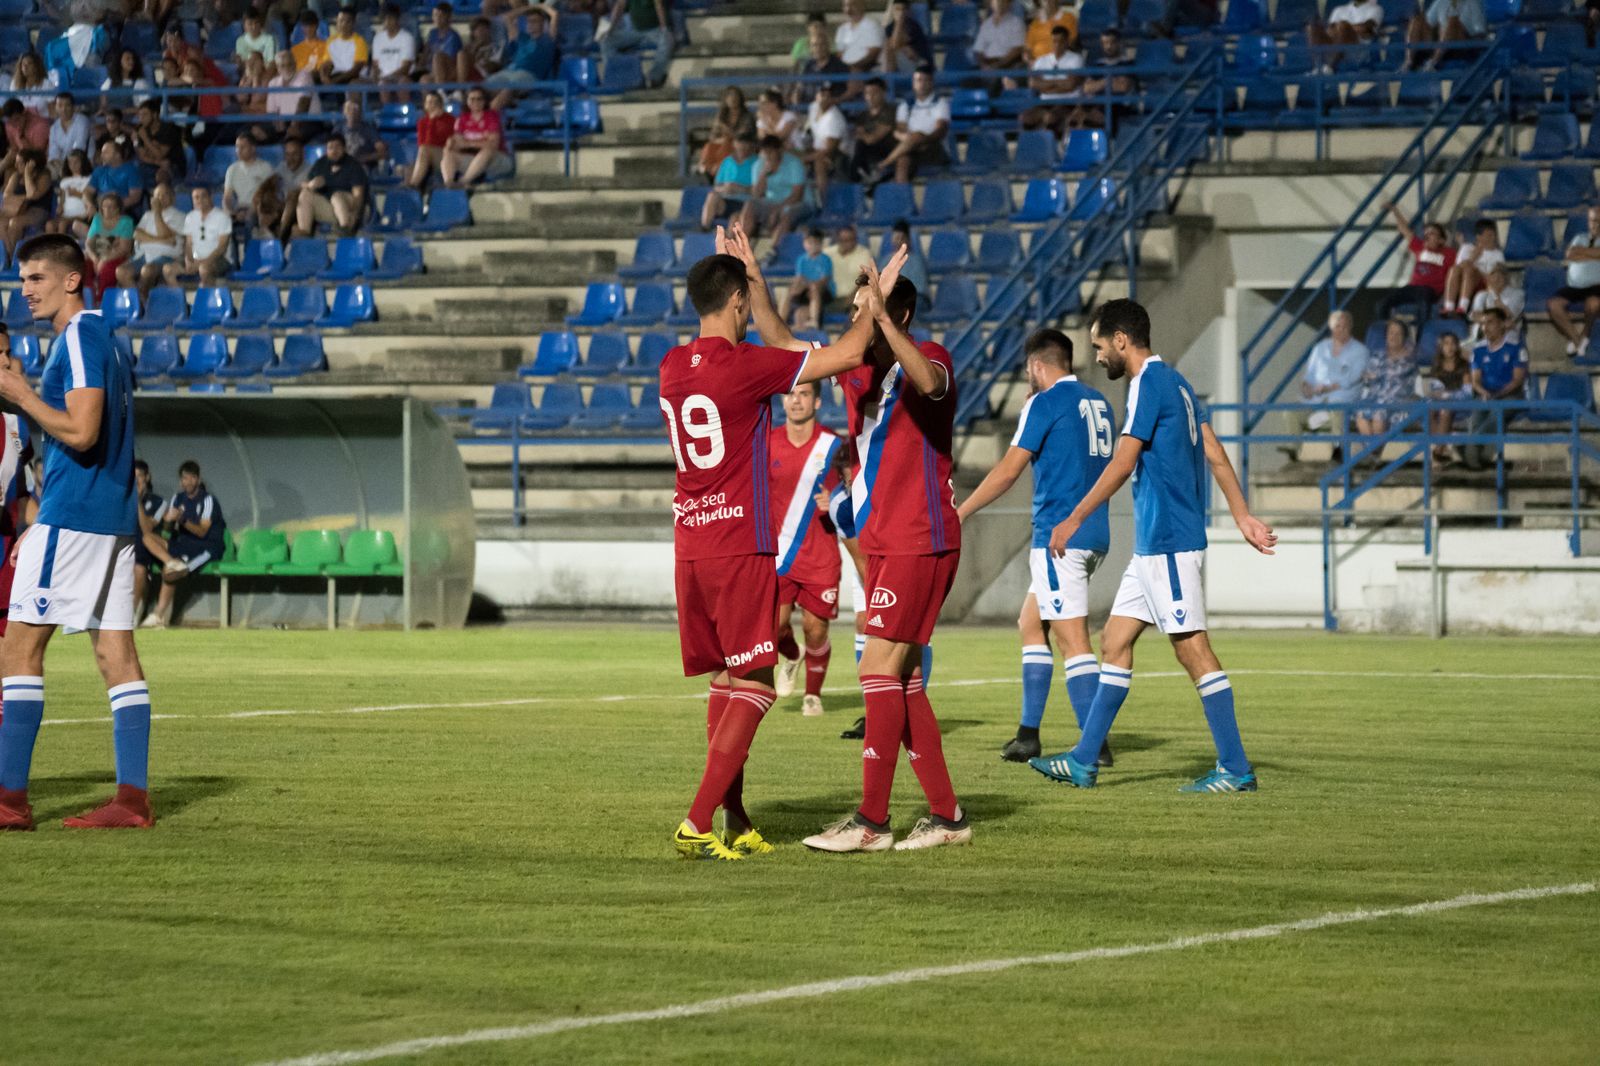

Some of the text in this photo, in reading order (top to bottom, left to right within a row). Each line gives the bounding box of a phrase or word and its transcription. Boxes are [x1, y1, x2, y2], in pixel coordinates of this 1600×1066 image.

[659, 394, 726, 472] 19
[1078, 398, 1113, 458] 15
[702, 492, 726, 508] sea
[695, 505, 744, 527] Huelva
[724, 640, 774, 668] ROMRO
